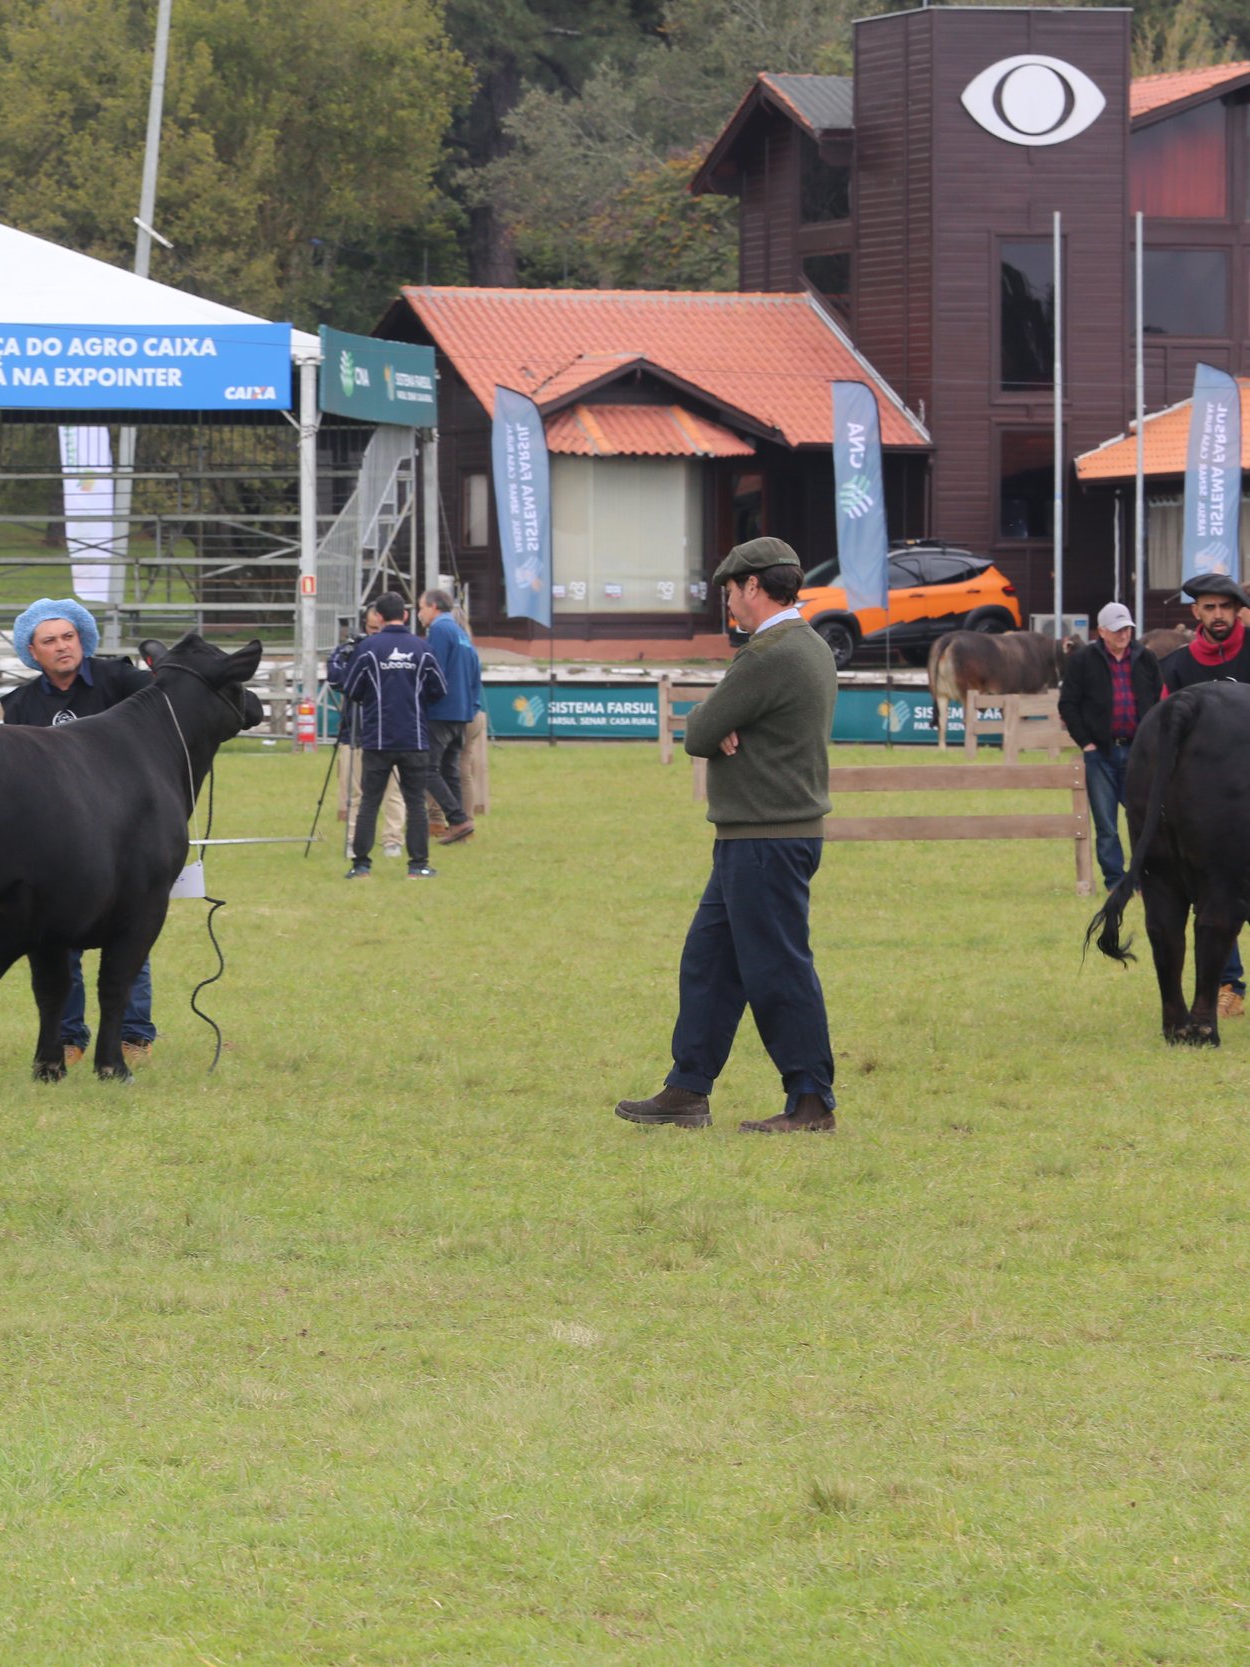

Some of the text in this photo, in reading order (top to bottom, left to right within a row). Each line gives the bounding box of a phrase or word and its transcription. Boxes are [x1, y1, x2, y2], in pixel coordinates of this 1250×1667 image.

[26, 337, 63, 356] DO
[67, 337, 138, 357] AGRO
[143, 337, 217, 357] CAIXA
[12, 367, 50, 387] NA
[54, 367, 183, 388] EXPOINTER
[224, 386, 277, 401] CAIXA
[547, 701, 657, 714] SISTEMA FARSUL
